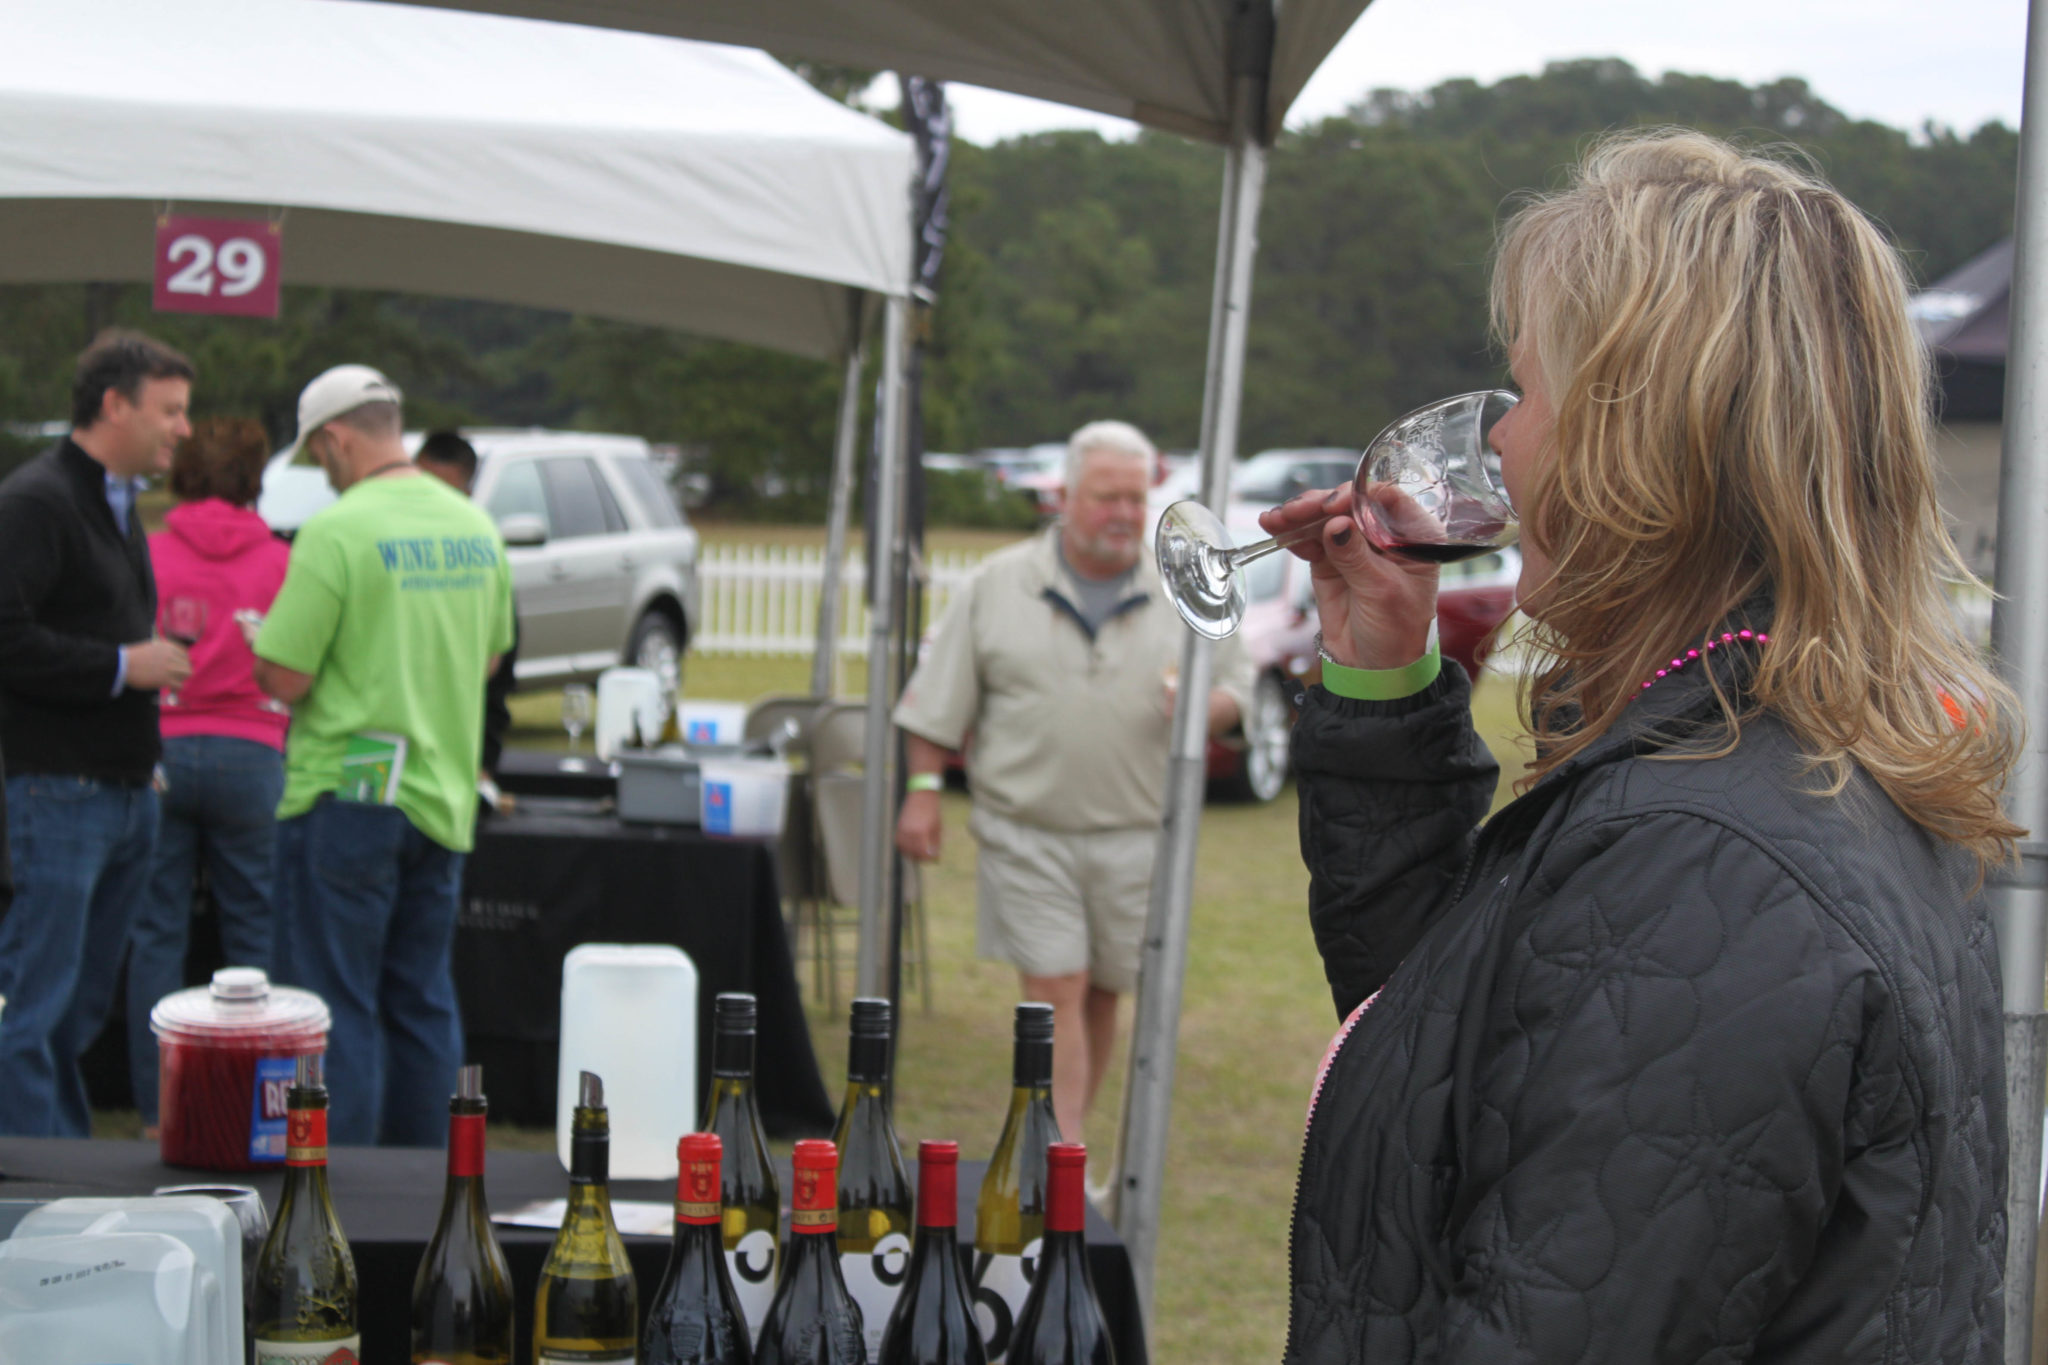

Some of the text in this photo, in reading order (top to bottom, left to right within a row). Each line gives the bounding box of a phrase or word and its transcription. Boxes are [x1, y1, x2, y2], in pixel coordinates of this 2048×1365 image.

[167, 235, 266, 296] 29
[376, 535, 498, 571] WINE BOSS
